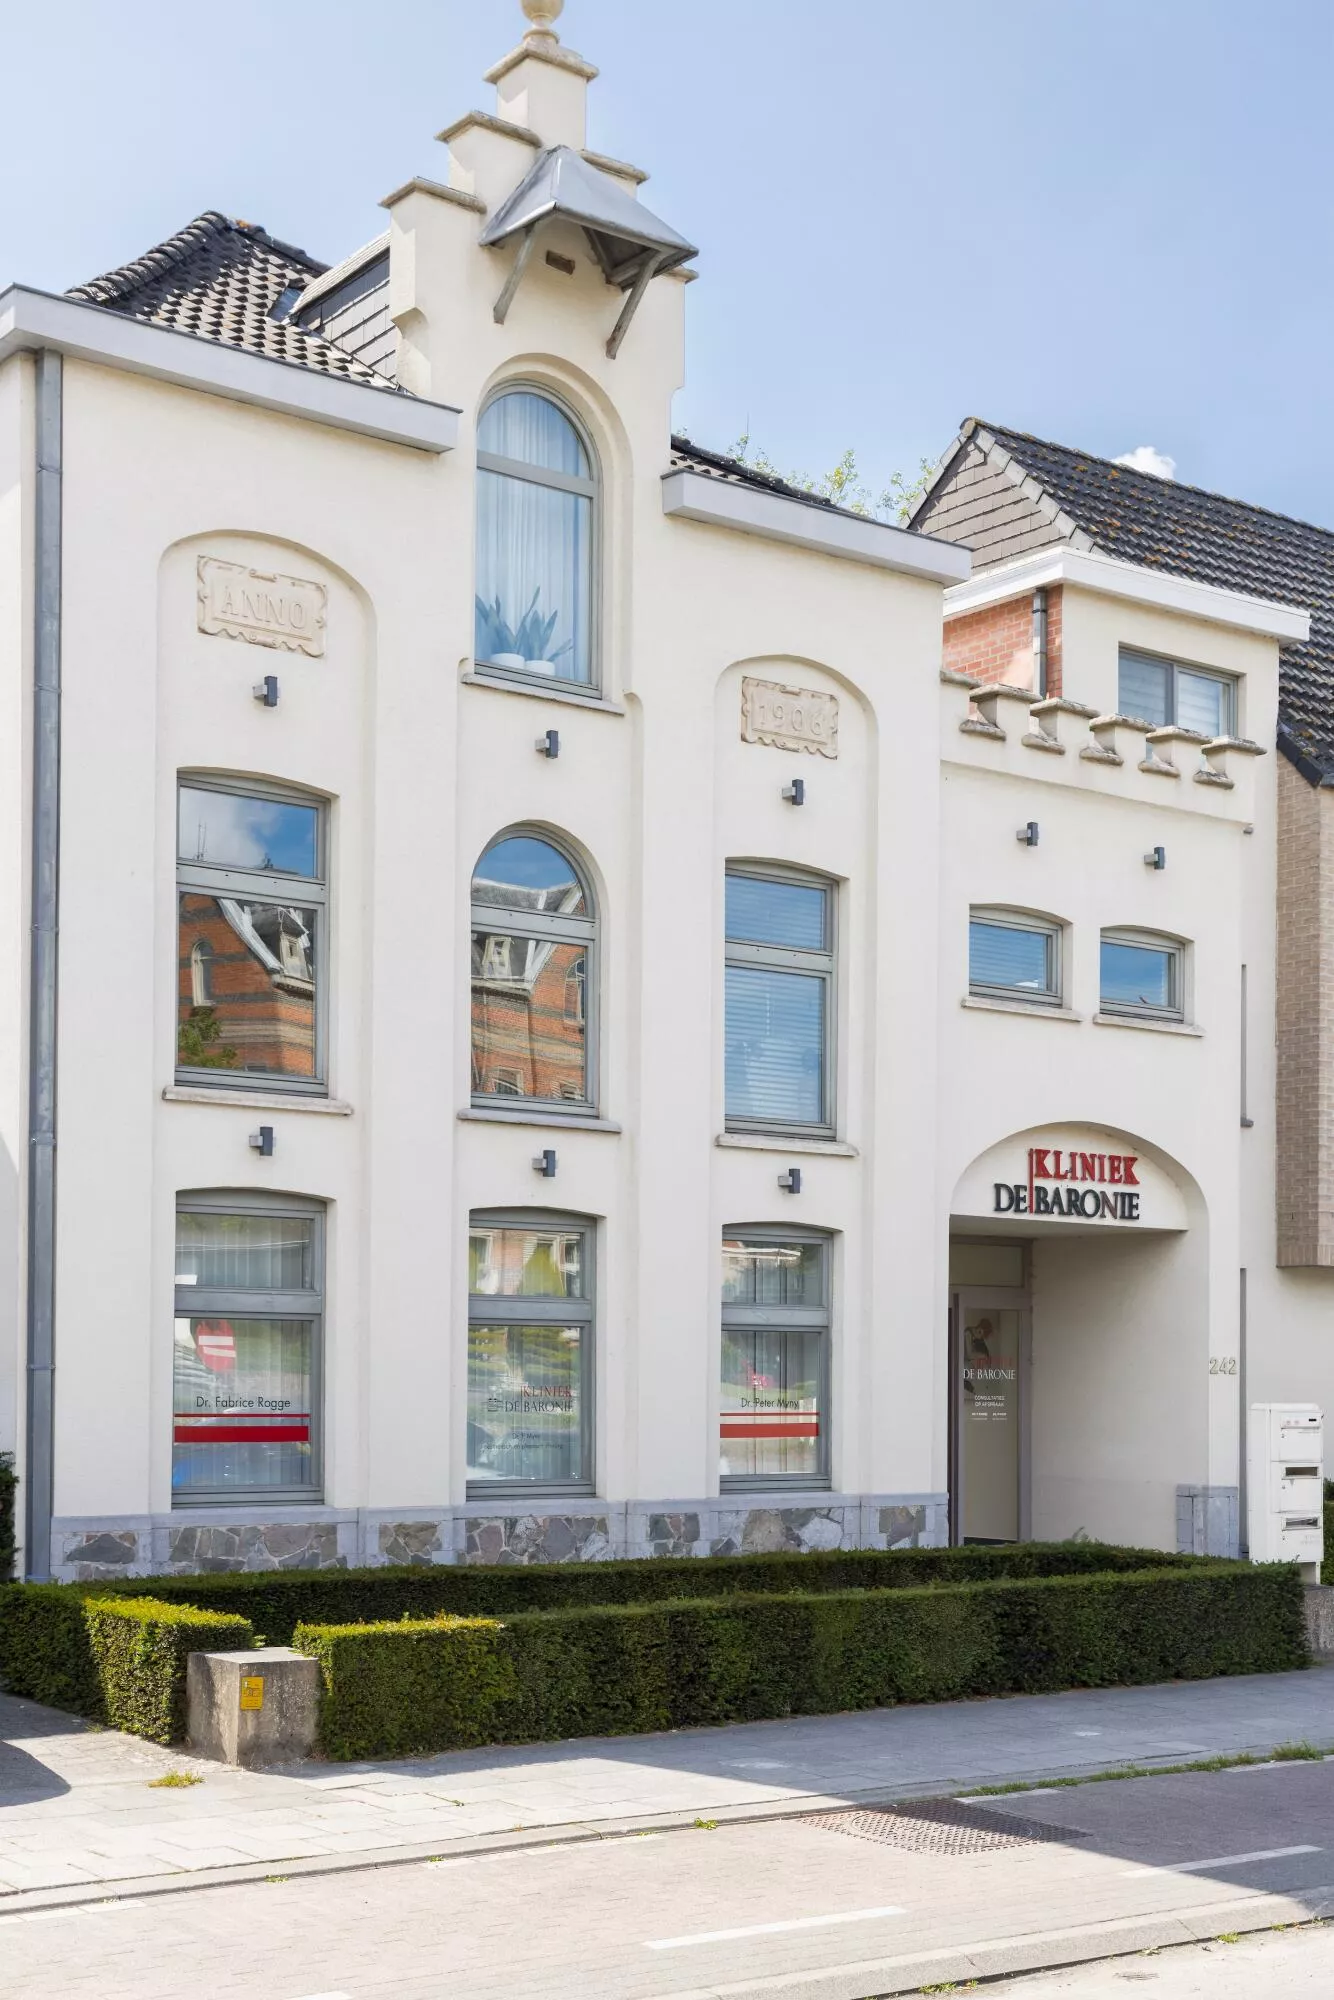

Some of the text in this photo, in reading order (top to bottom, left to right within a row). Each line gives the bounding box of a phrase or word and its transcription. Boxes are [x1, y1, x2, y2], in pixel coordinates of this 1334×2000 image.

[221, 586, 307, 630] ANNO
[1033, 1148, 1140, 1185] KLINIEK
[994, 1183, 1140, 1220] DE BARONIE
[977, 1368, 1016, 1381] BARONIE
[1209, 1357, 1237, 1375] 242
[523, 1385, 572, 1398] KLINIEK
[196, 1396, 291, 1411] Dr. Fabrice Rogge
